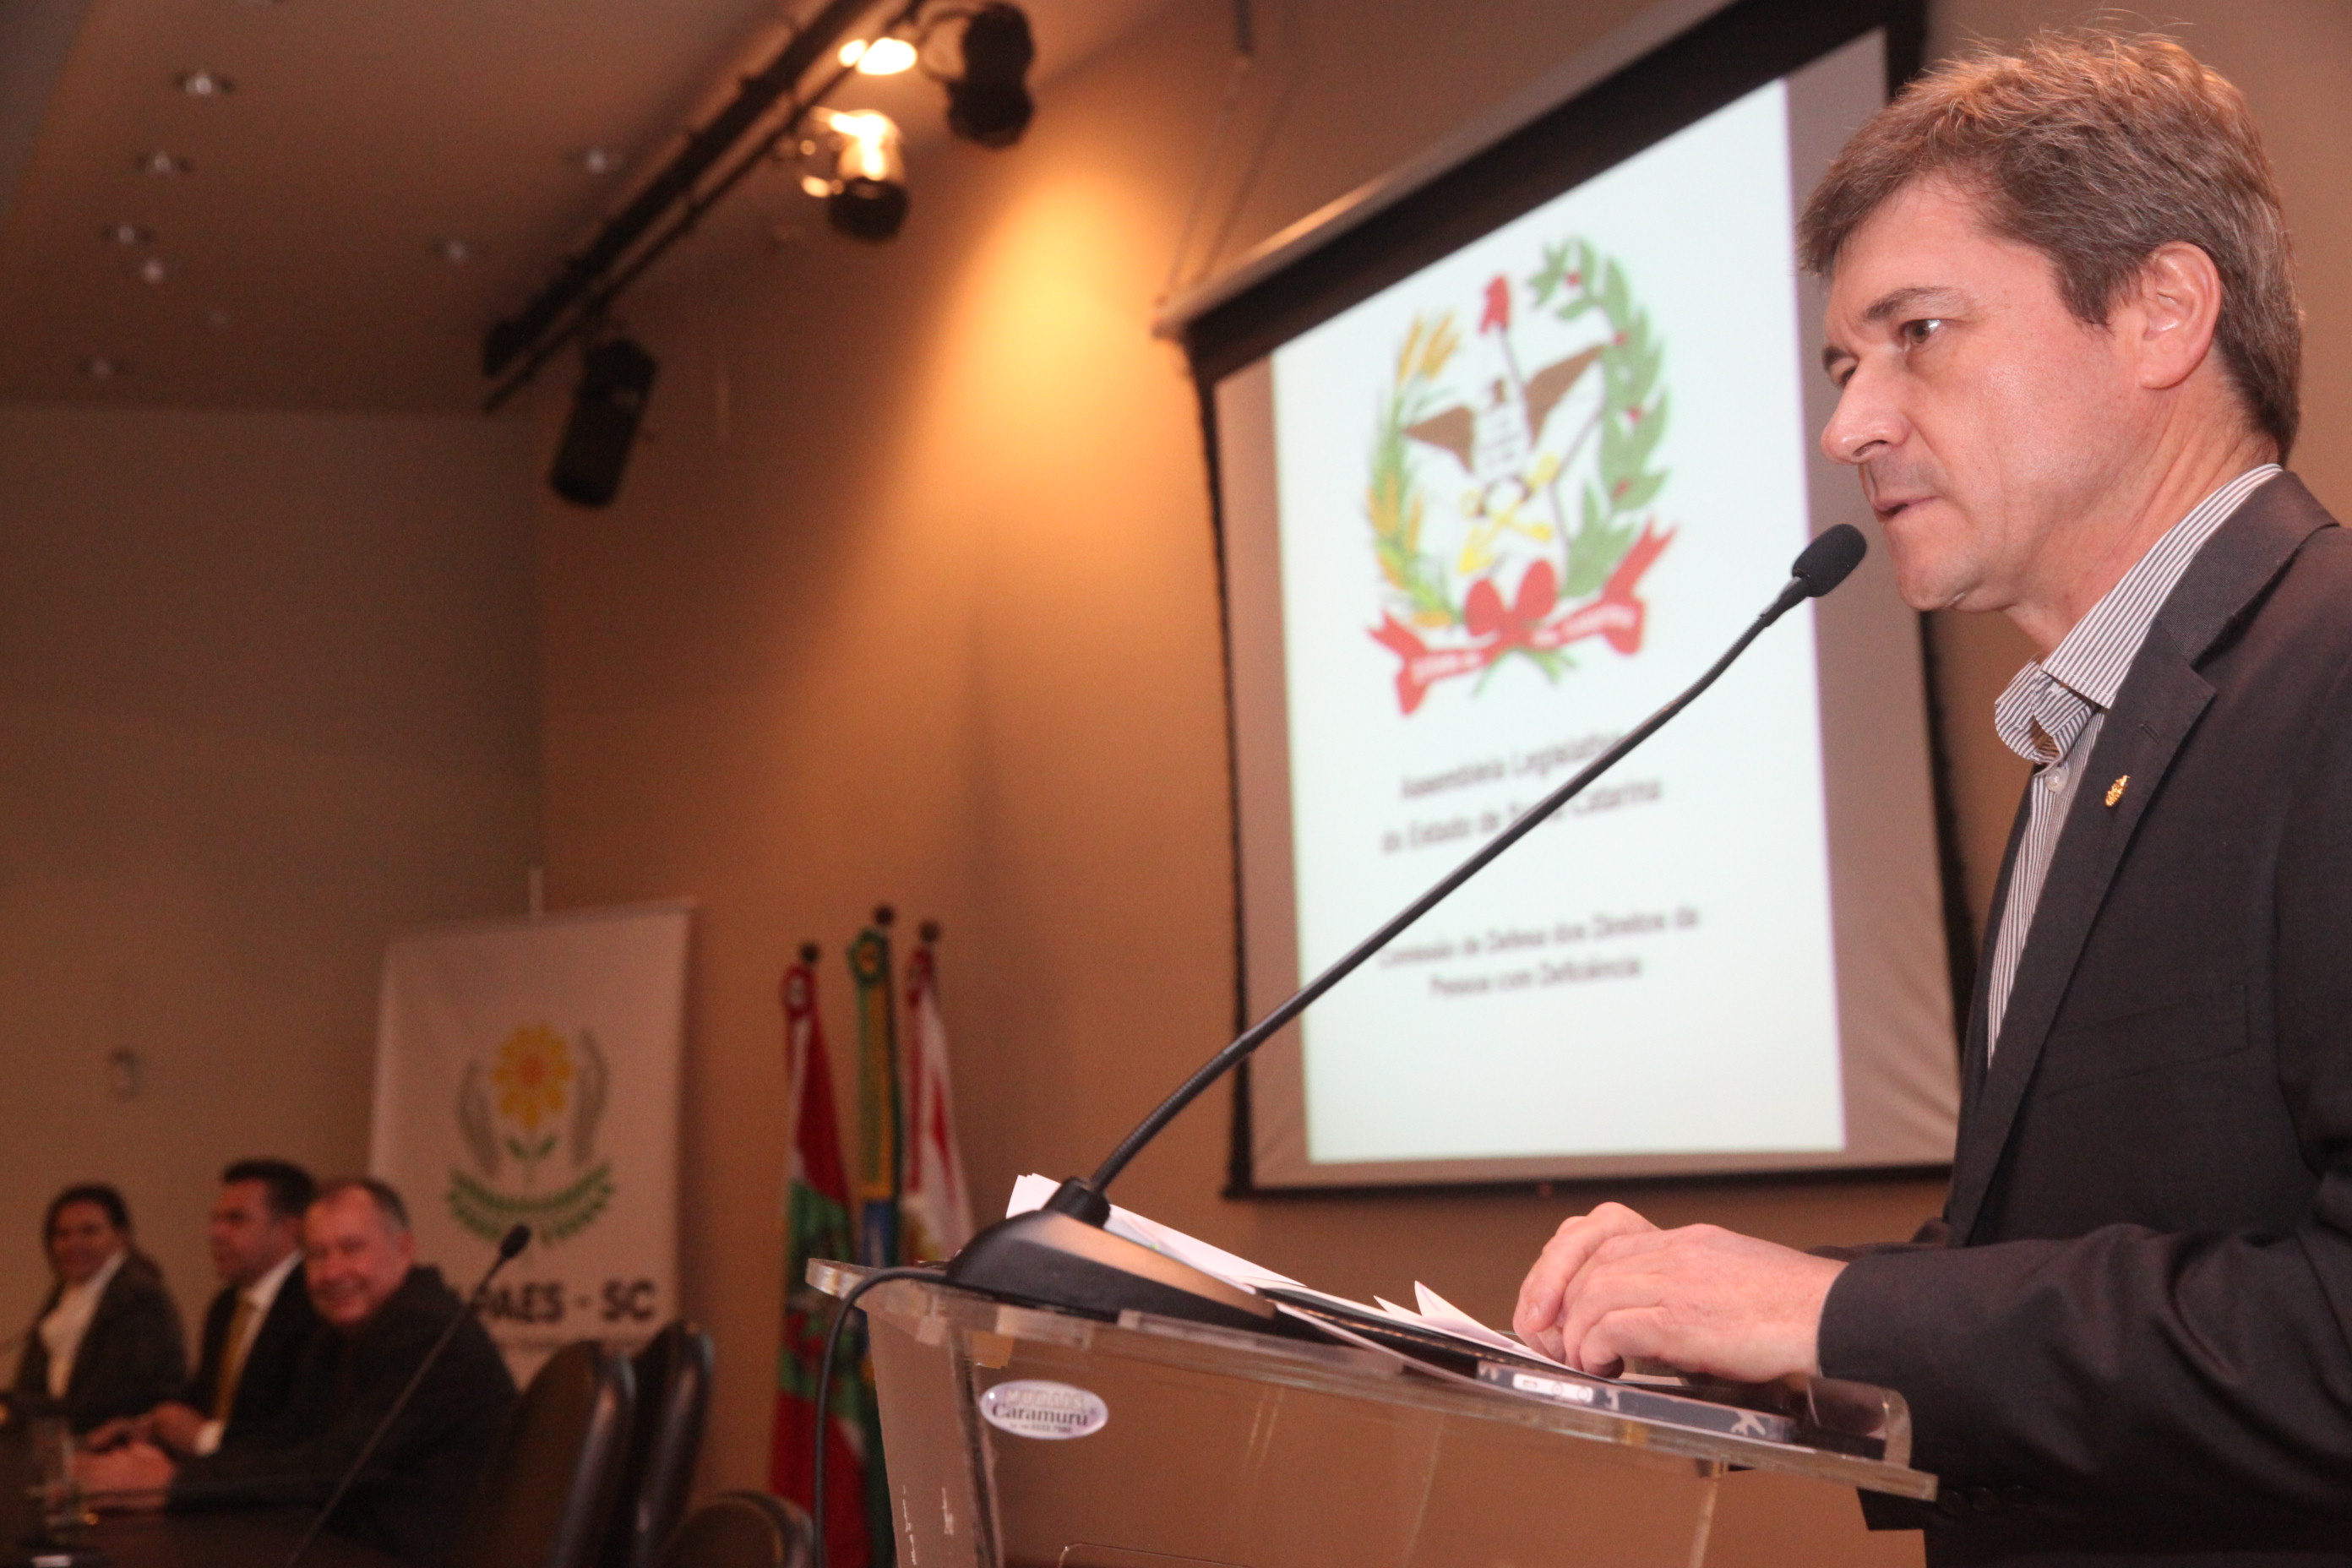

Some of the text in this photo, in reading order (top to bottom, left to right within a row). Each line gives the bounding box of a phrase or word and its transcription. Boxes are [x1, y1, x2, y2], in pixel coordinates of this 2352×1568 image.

[1408, 813, 1472, 847] Estado
[603, 1279, 654, 1320] SC
[992, 1403, 1087, 1426] Caramuru
